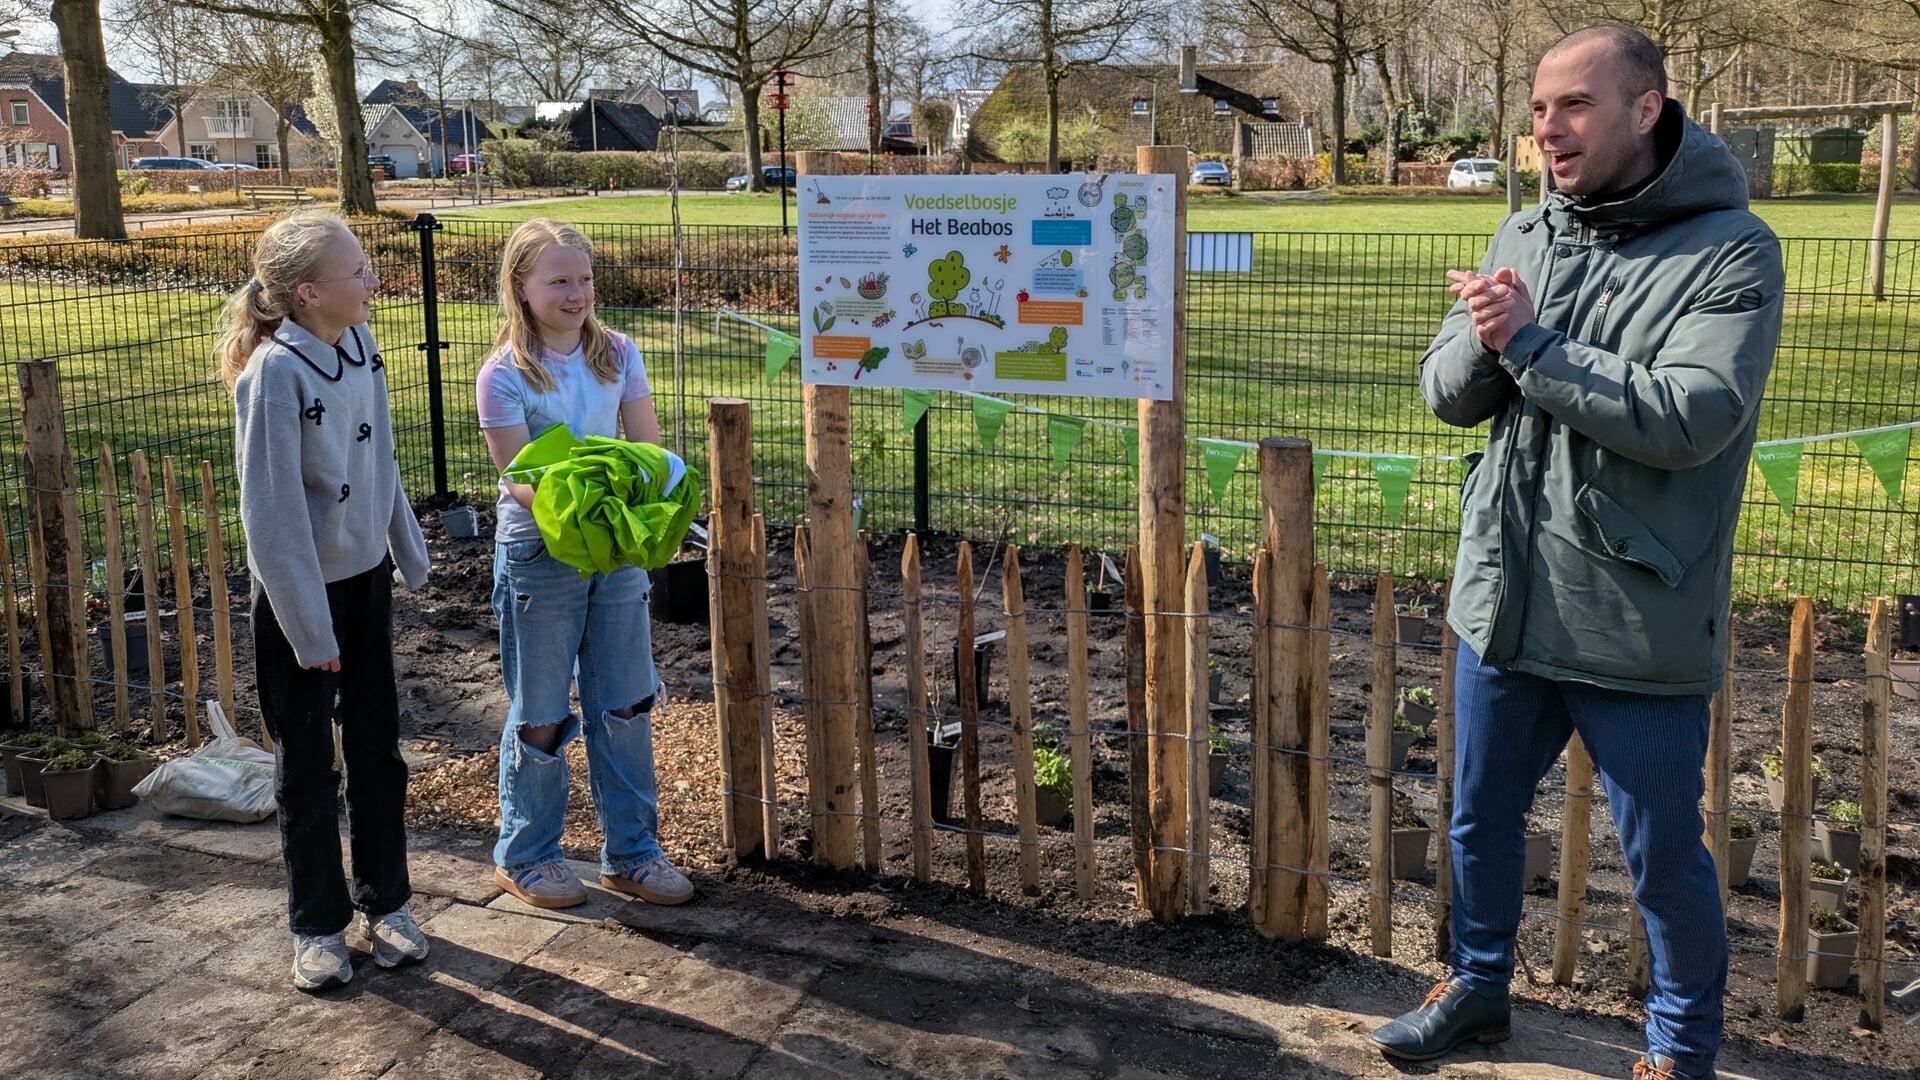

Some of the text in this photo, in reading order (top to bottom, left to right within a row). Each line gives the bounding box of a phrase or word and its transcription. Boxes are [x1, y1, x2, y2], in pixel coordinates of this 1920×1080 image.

[904, 193, 1017, 214] Voedselbosje
[911, 218, 942, 235] Het
[947, 218, 1013, 236] Beabos
